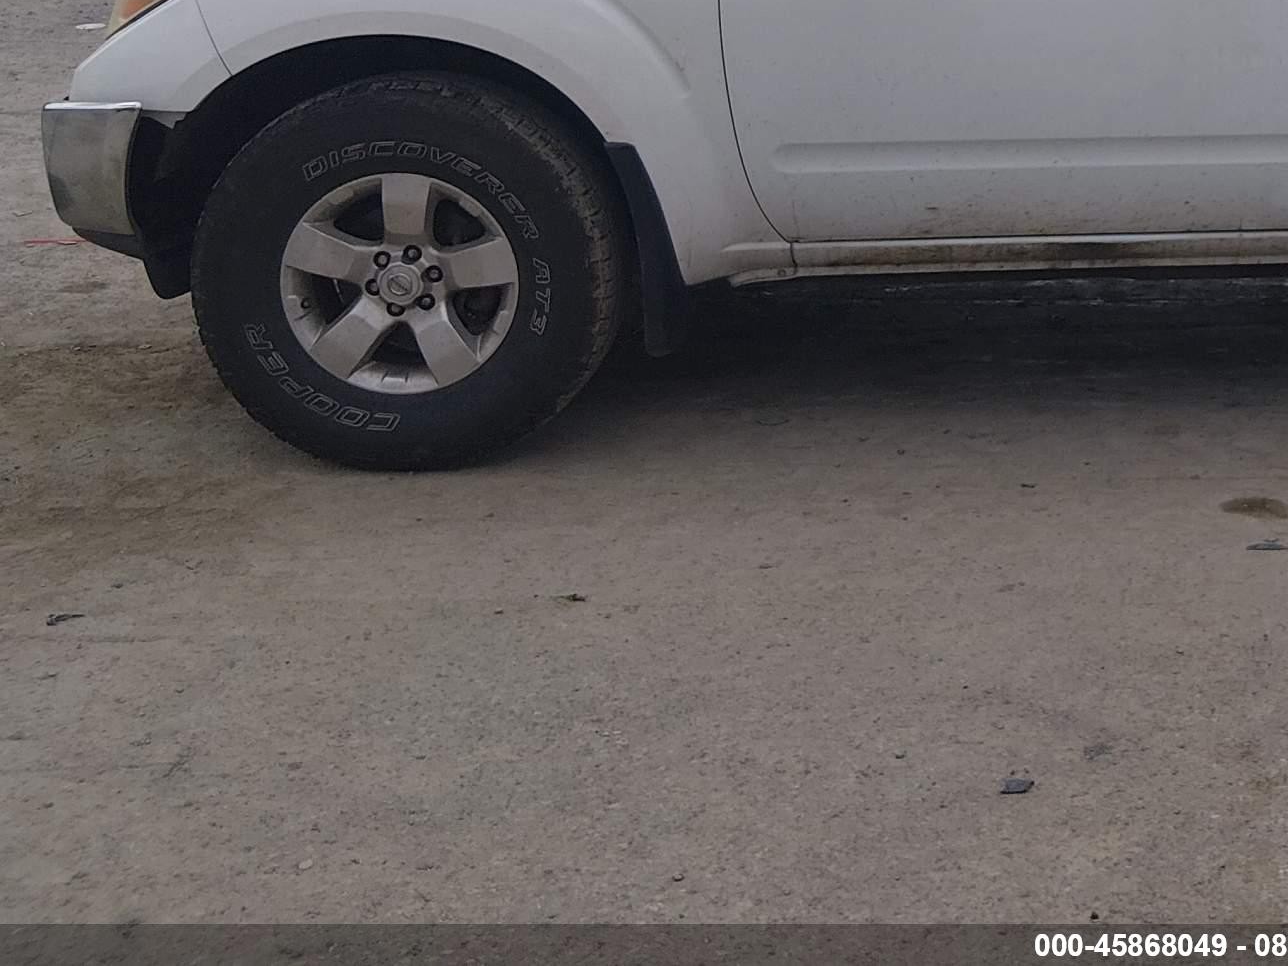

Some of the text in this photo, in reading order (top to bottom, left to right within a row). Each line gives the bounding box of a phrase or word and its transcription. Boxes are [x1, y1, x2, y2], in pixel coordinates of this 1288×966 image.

[303, 141, 551, 336] DISCOVERER AT3
[244, 322, 400, 432] COOPER
